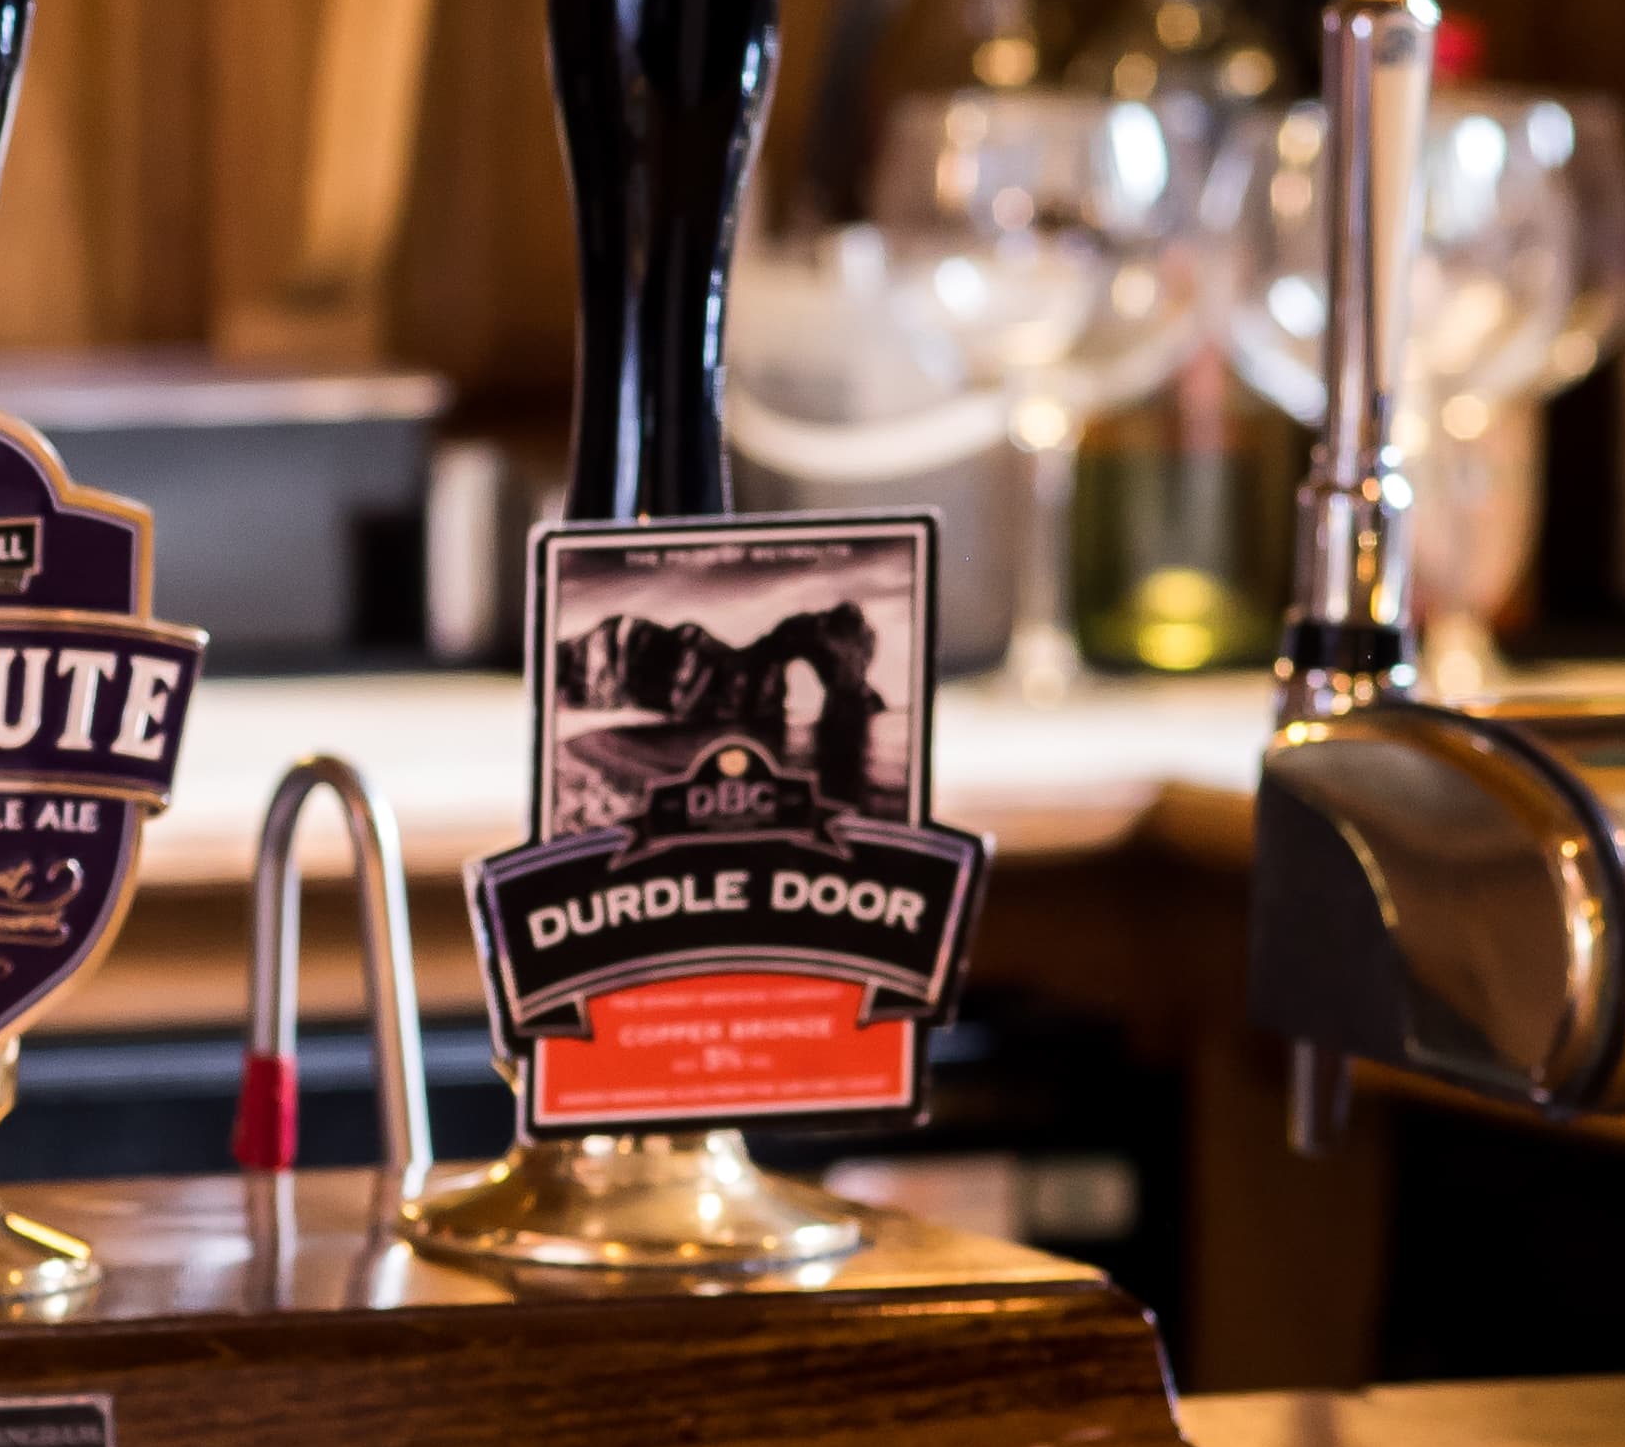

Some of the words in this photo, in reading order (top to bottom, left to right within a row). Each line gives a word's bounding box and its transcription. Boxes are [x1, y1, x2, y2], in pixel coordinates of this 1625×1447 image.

[35, 800, 98, 833] ALE
[526, 870, 750, 950] DURDLE
[771, 871, 927, 934] DOOR
